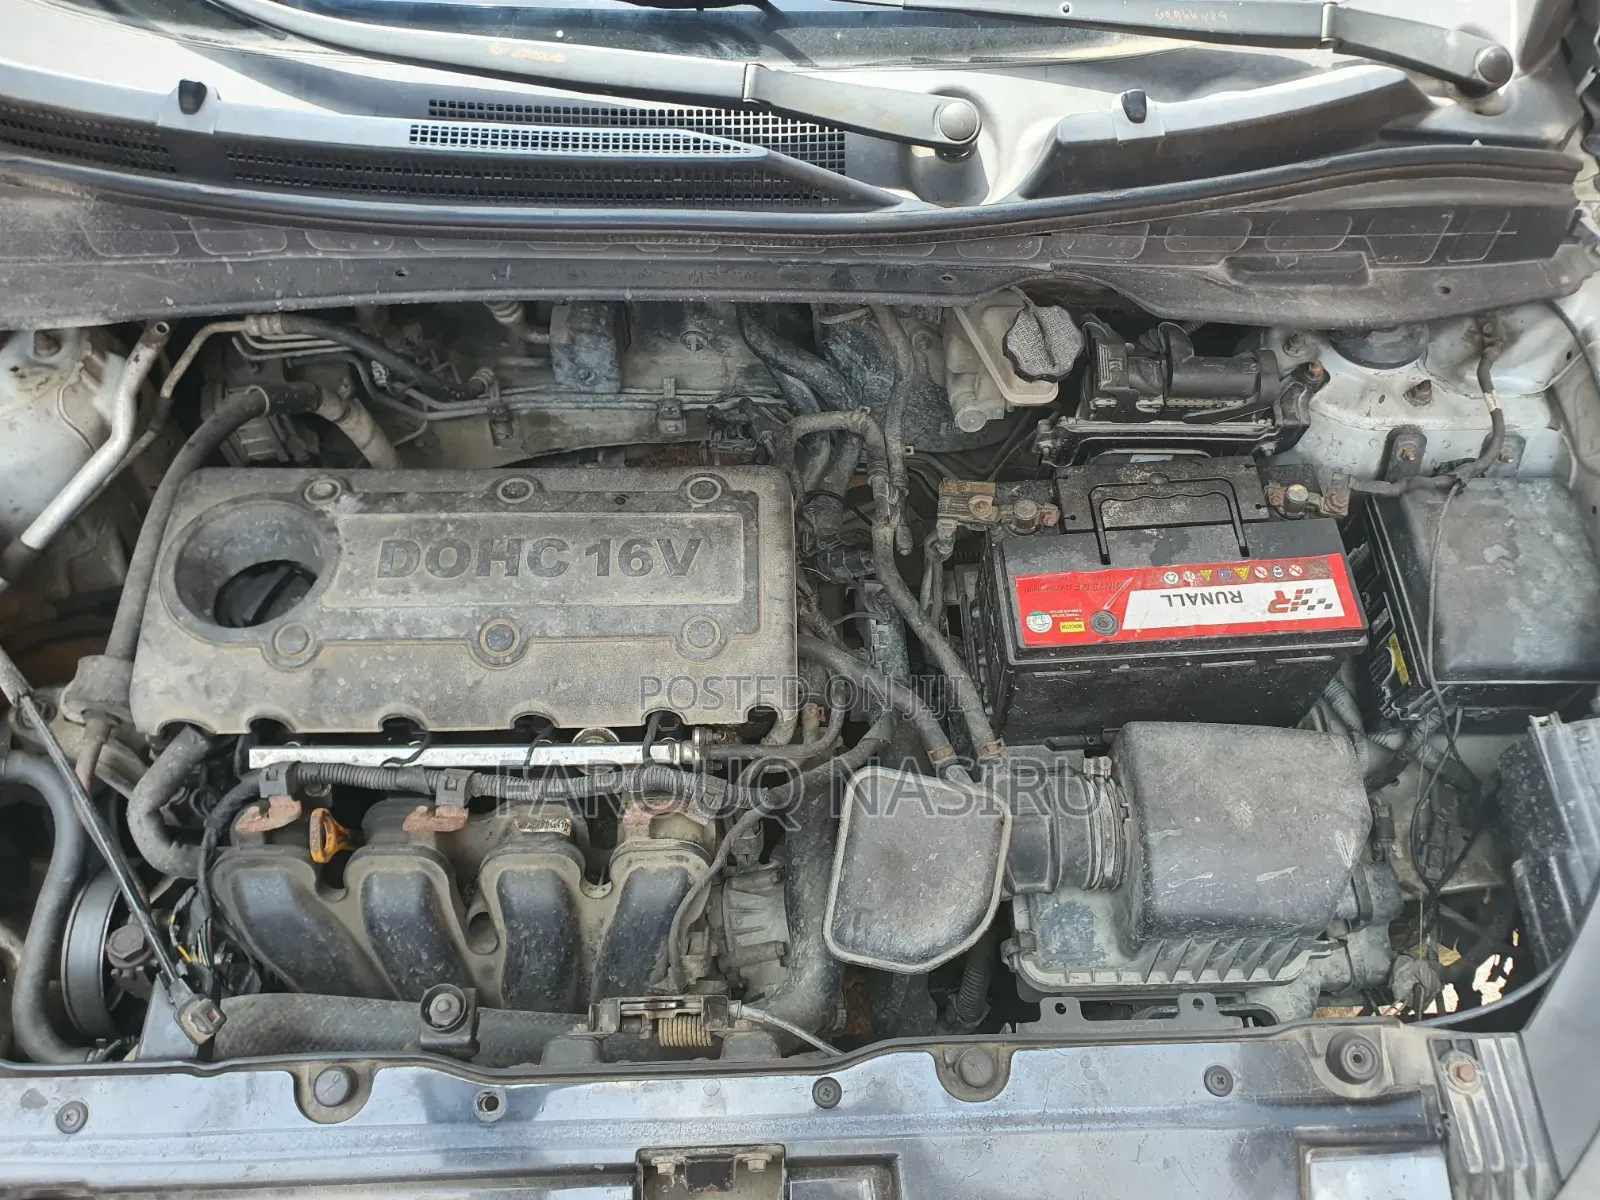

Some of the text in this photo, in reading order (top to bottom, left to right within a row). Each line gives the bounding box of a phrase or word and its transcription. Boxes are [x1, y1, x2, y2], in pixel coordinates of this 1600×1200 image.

[376, 537, 702, 579] DOHC 16V
[1160, 590, 1244, 605] RUNALL
